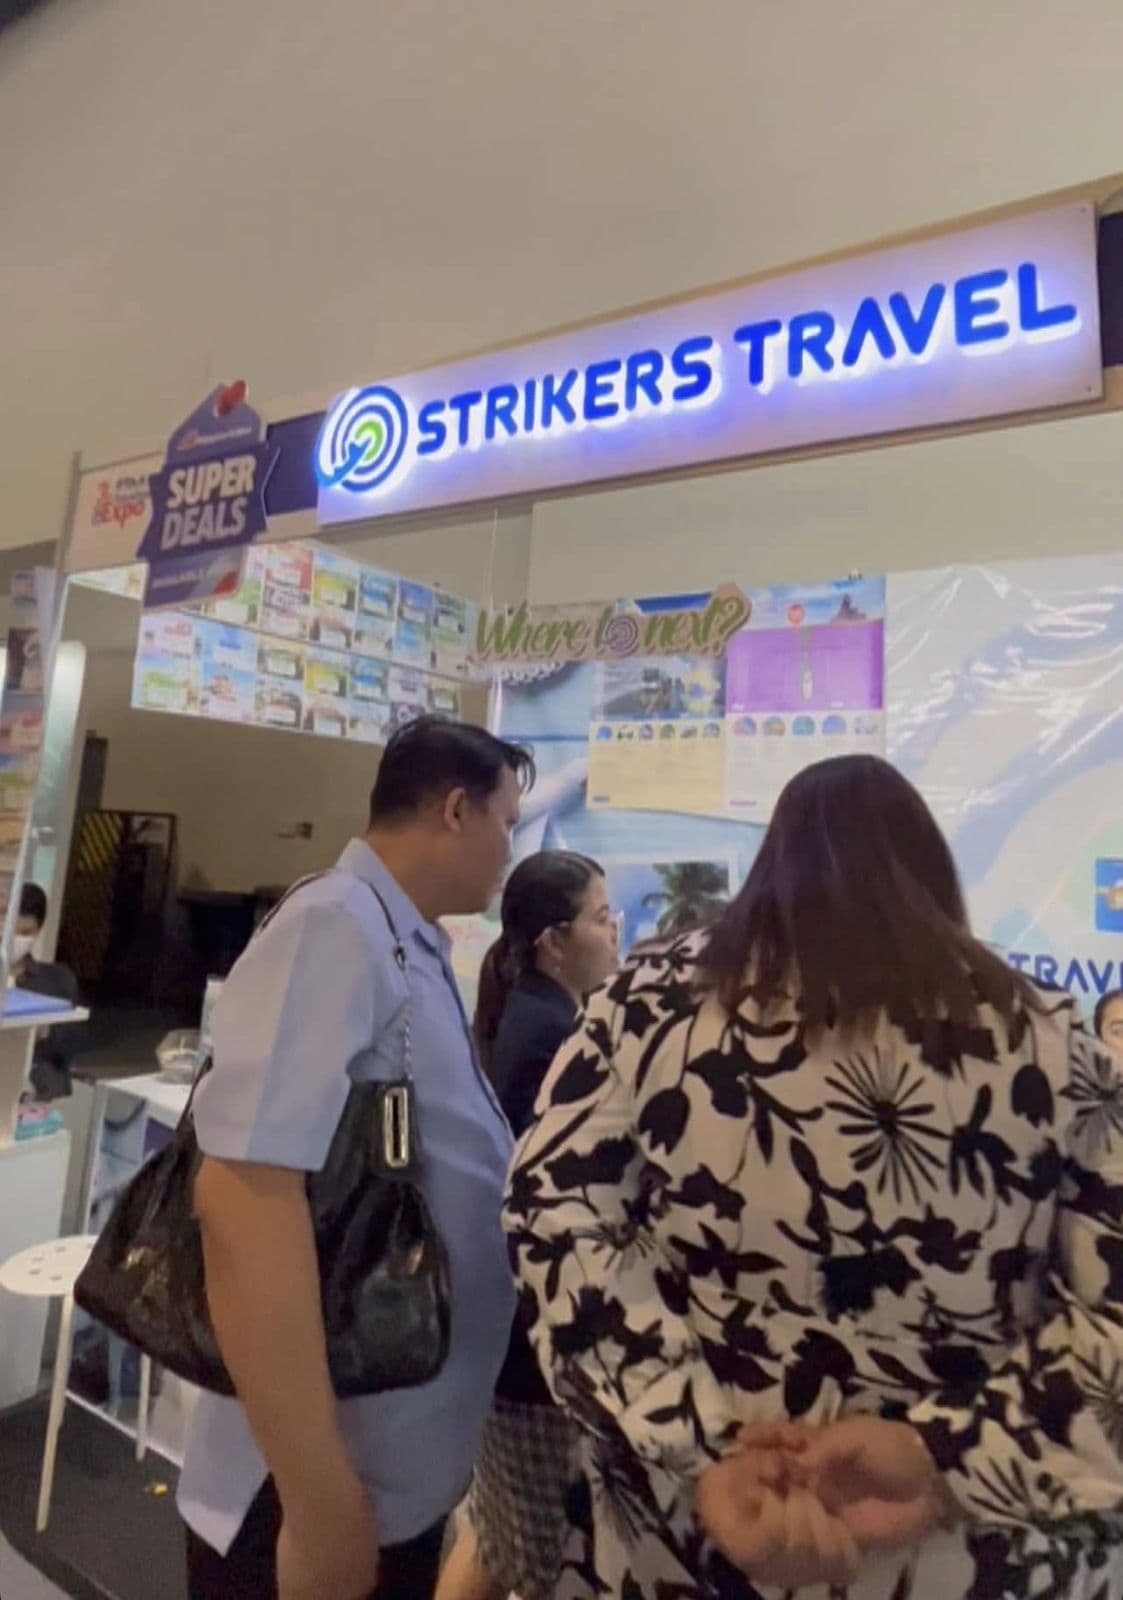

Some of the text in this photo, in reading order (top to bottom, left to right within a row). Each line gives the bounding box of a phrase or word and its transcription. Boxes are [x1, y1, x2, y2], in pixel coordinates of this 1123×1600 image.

[416, 261, 1078, 456] STRIKERS TRAVEL
[166, 455, 257, 509] SUPER
[160, 497, 248, 550] DEALS
[476, 600, 588, 656] Where
[1008, 952, 1123, 993] TRAV
